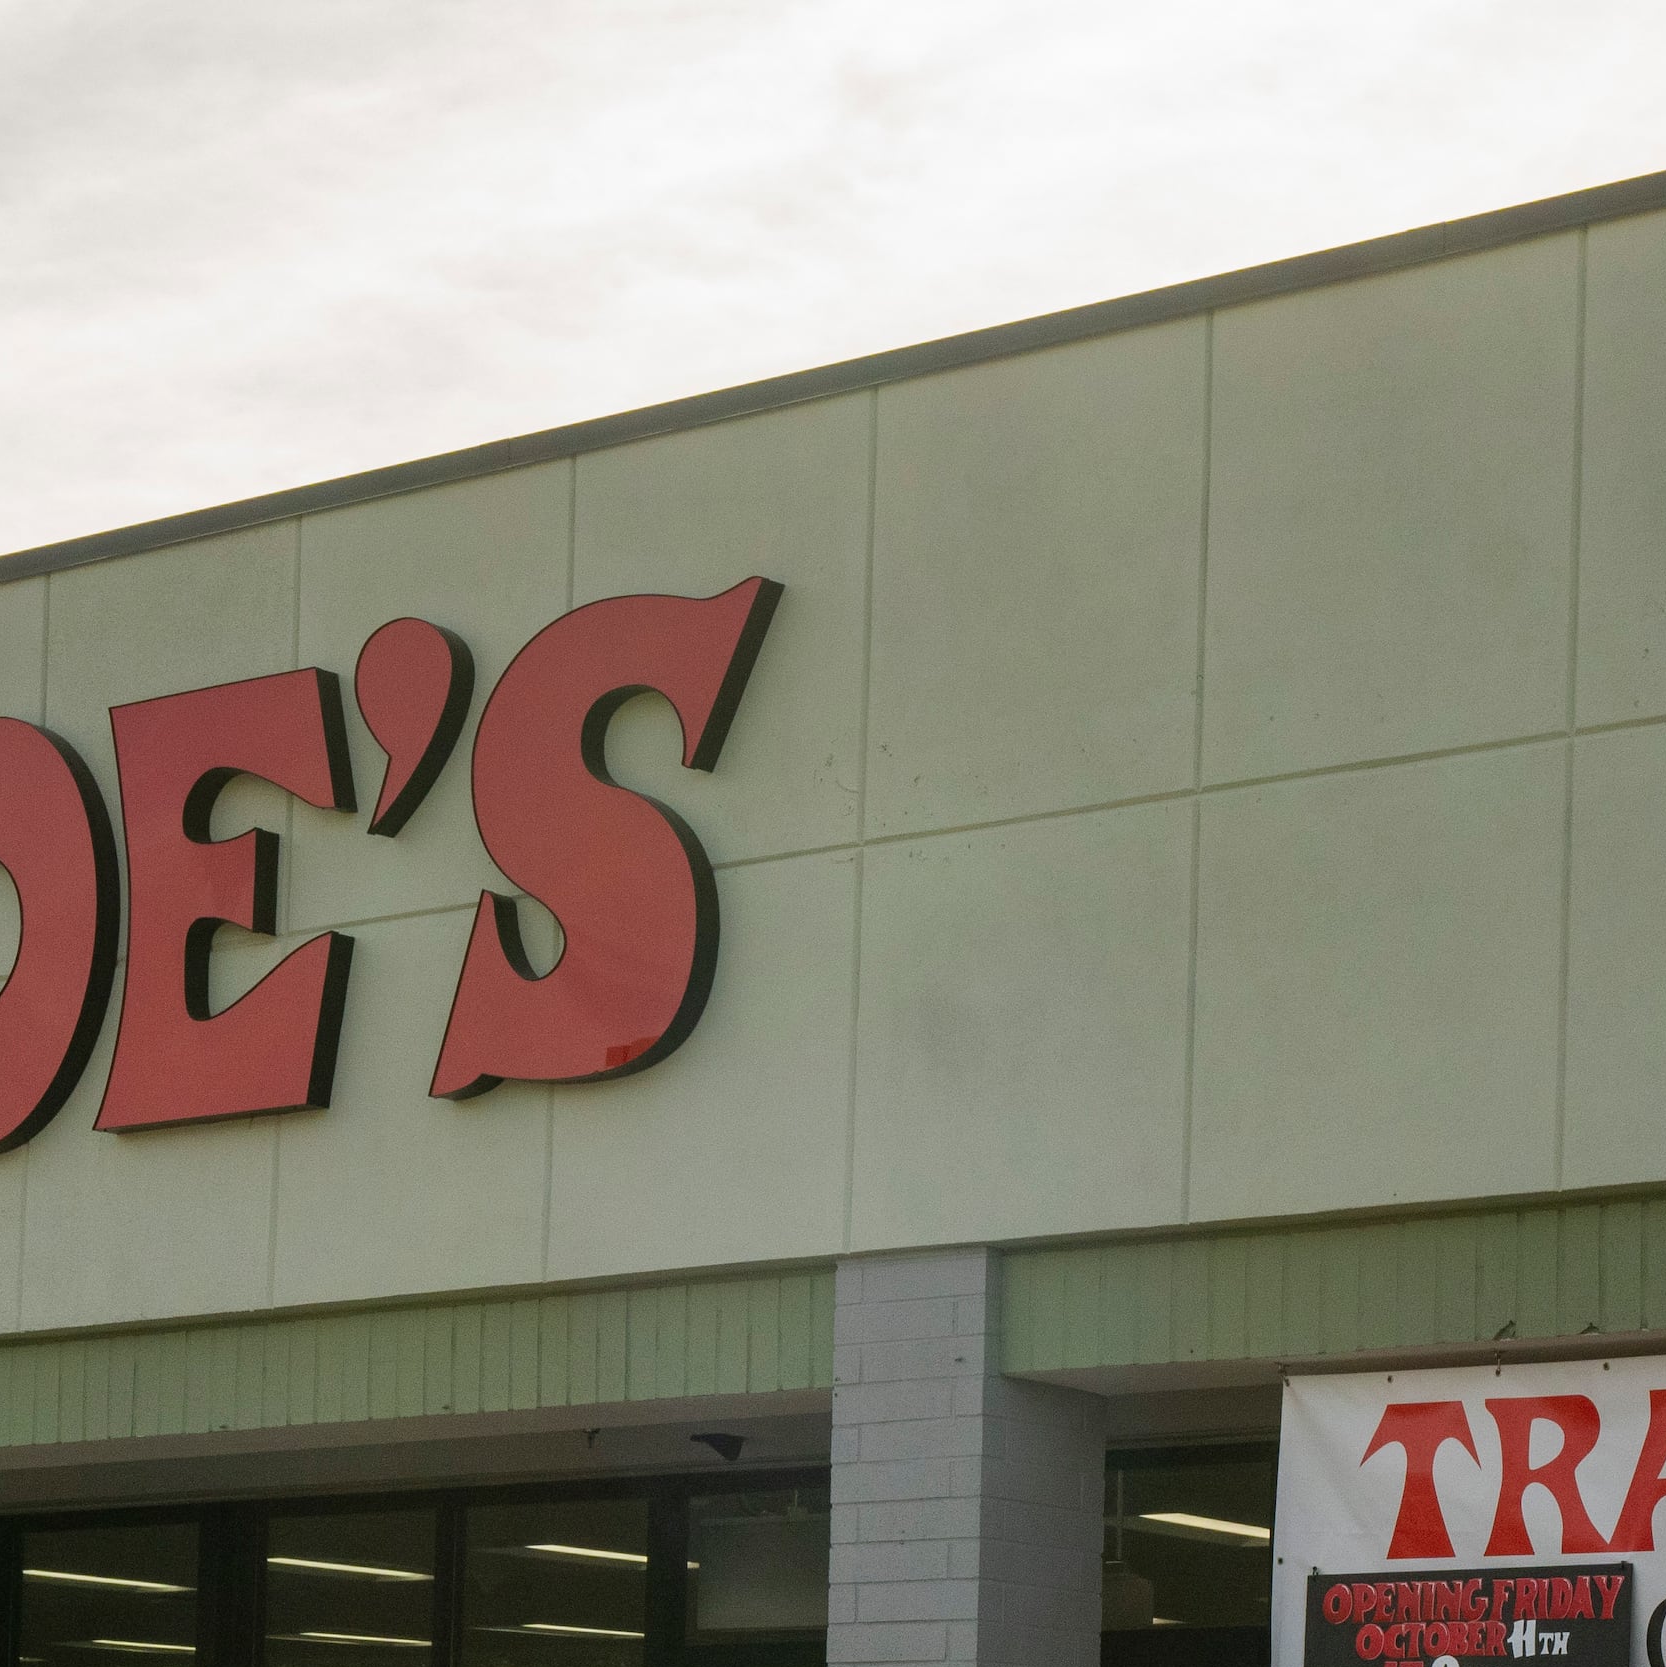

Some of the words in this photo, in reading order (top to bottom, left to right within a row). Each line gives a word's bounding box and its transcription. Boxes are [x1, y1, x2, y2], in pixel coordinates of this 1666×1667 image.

[1322, 1578, 1488, 1625] OPENING
[1491, 1575, 1626, 1620] FRIDAY
[1355, 1620, 1508, 1661] OCTOBER
